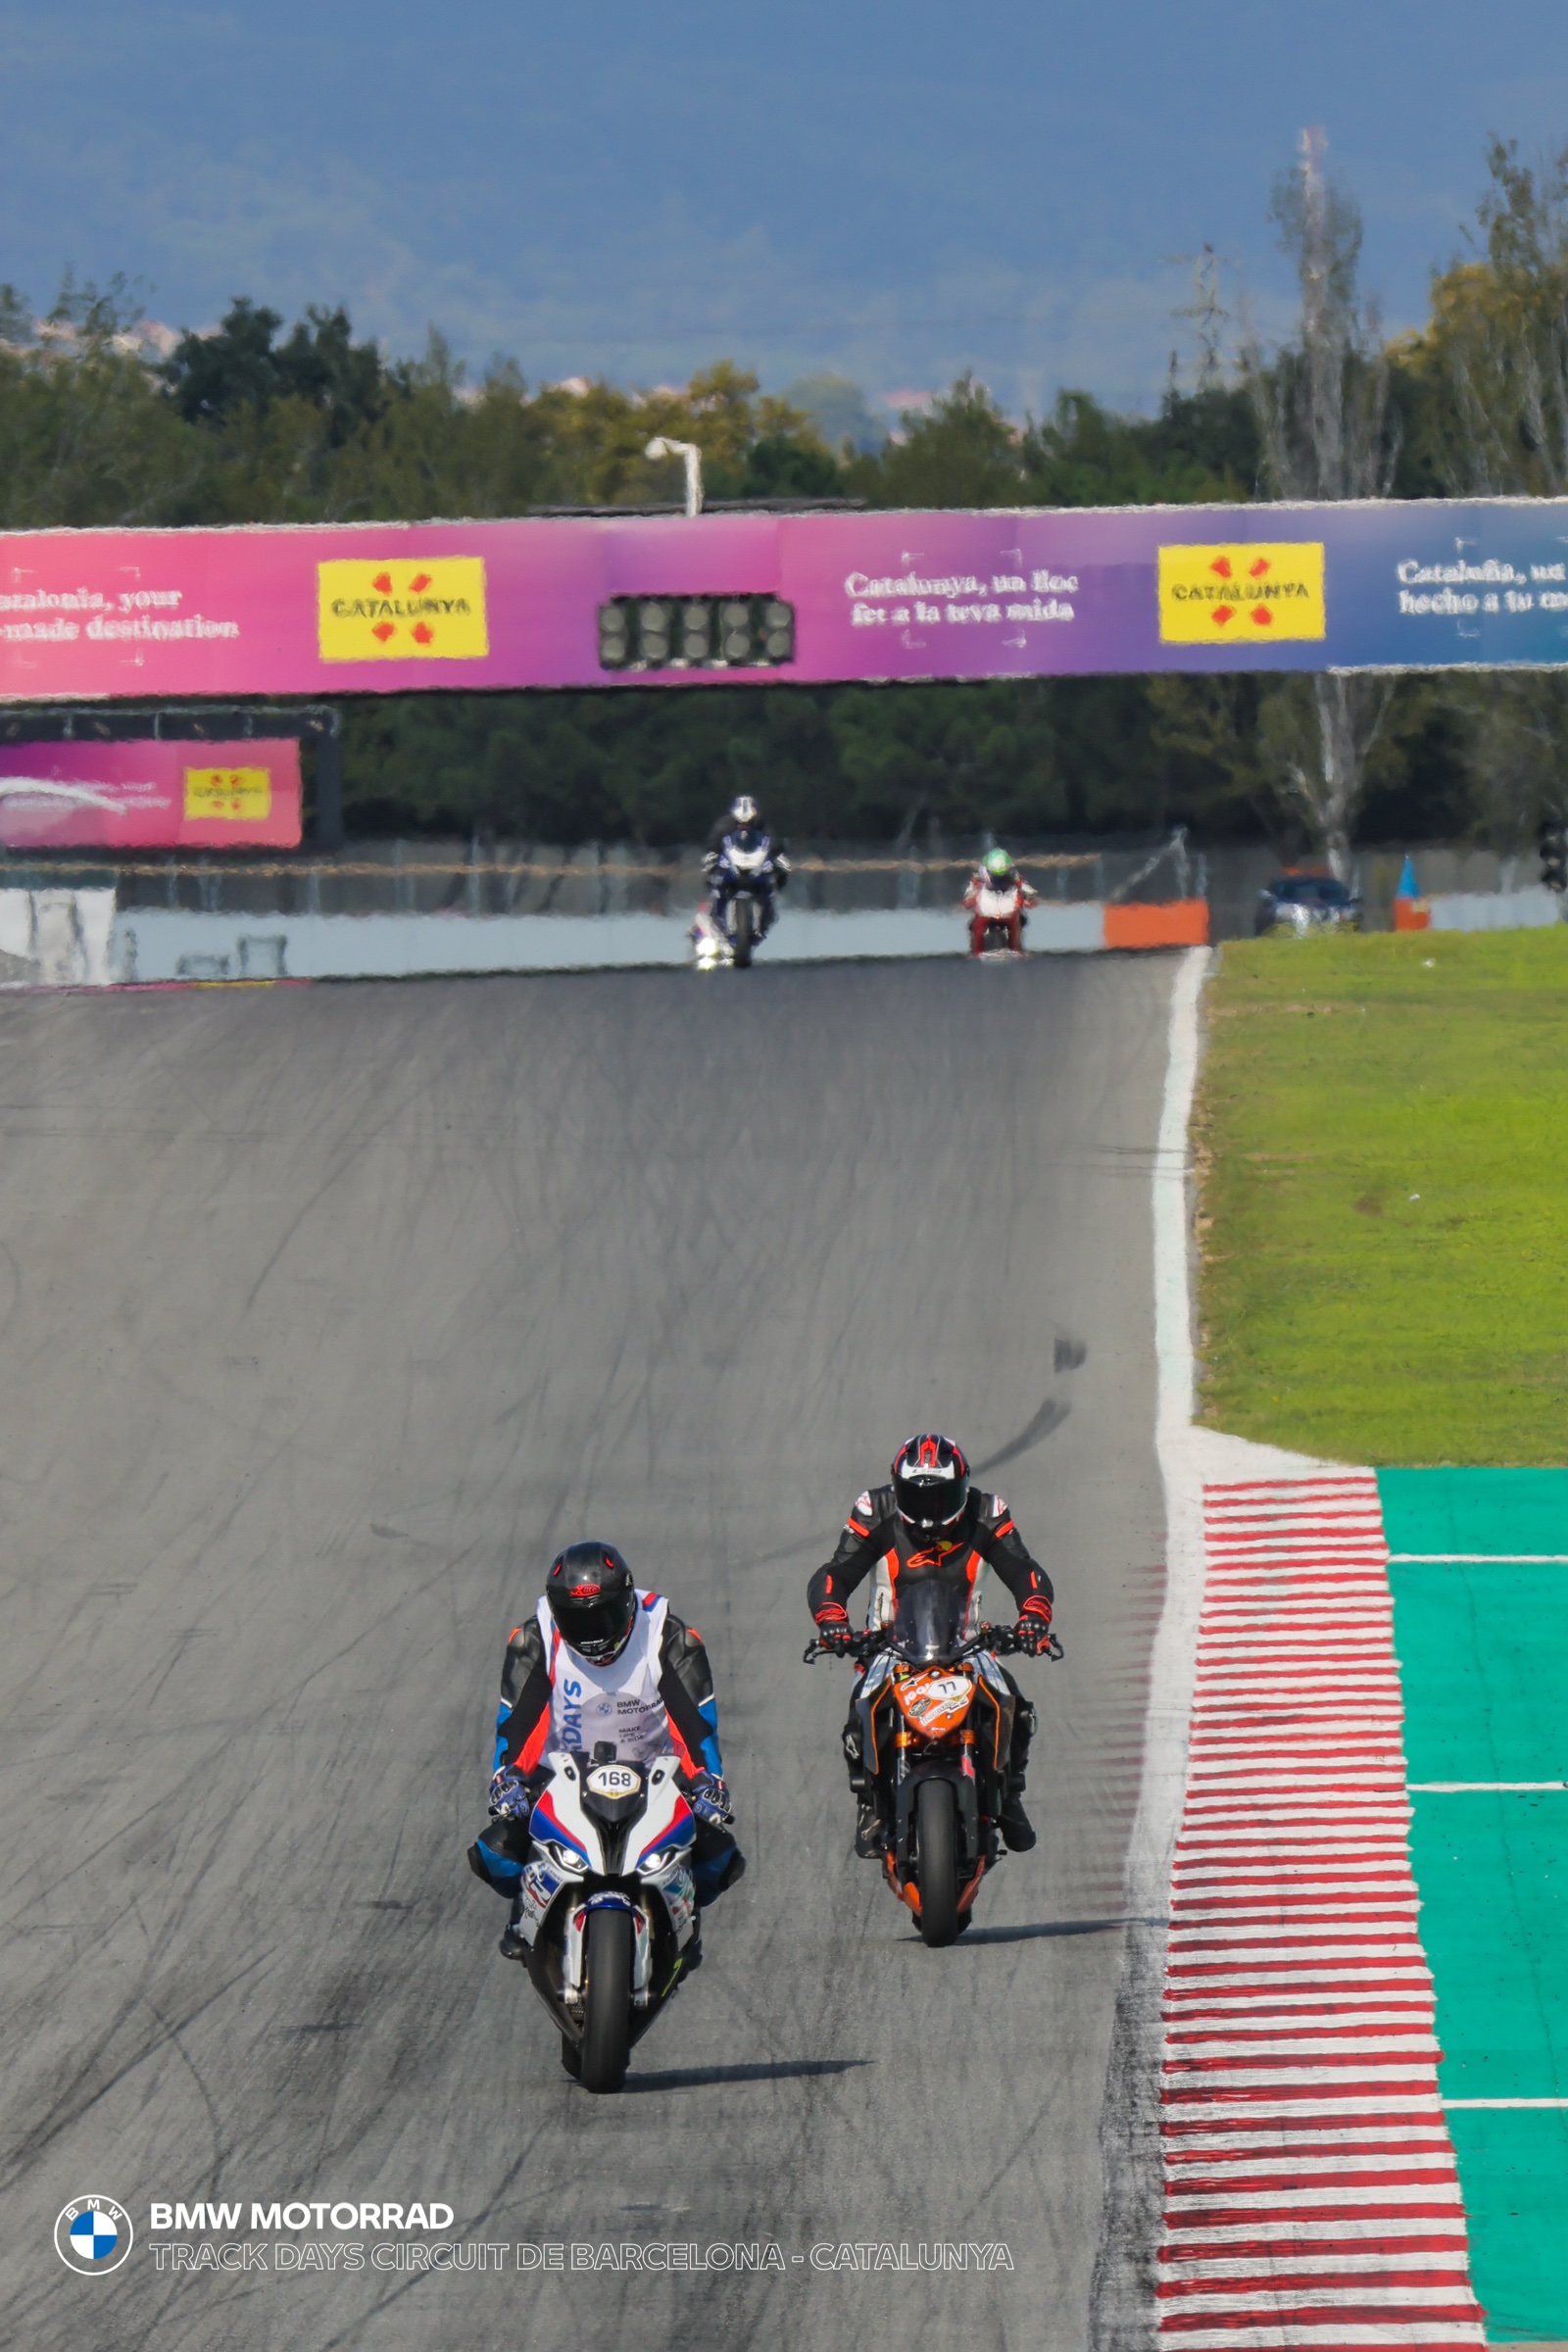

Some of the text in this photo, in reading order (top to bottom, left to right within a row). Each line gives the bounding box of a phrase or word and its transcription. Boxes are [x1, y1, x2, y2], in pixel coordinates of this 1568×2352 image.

[844, 571, 988, 599] Catalunya,
[1171, 582, 1310, 603] CATALUNYA
[0, 587, 183, 613] atalonia, your
[331, 597, 471, 619] CATALUNYA
[890, 606, 910, 624] a
[913, 600, 942, 624] la
[1398, 587, 1480, 614] hecho
[1482, 592, 1500, 612] a
[85, 613, 240, 642] destination
[938, 1681, 956, 1694] 77
[562, 1679, 582, 1751] DAYS
[616, 1699, 640, 1708] BMW
[598, 1771, 631, 1787] 168
